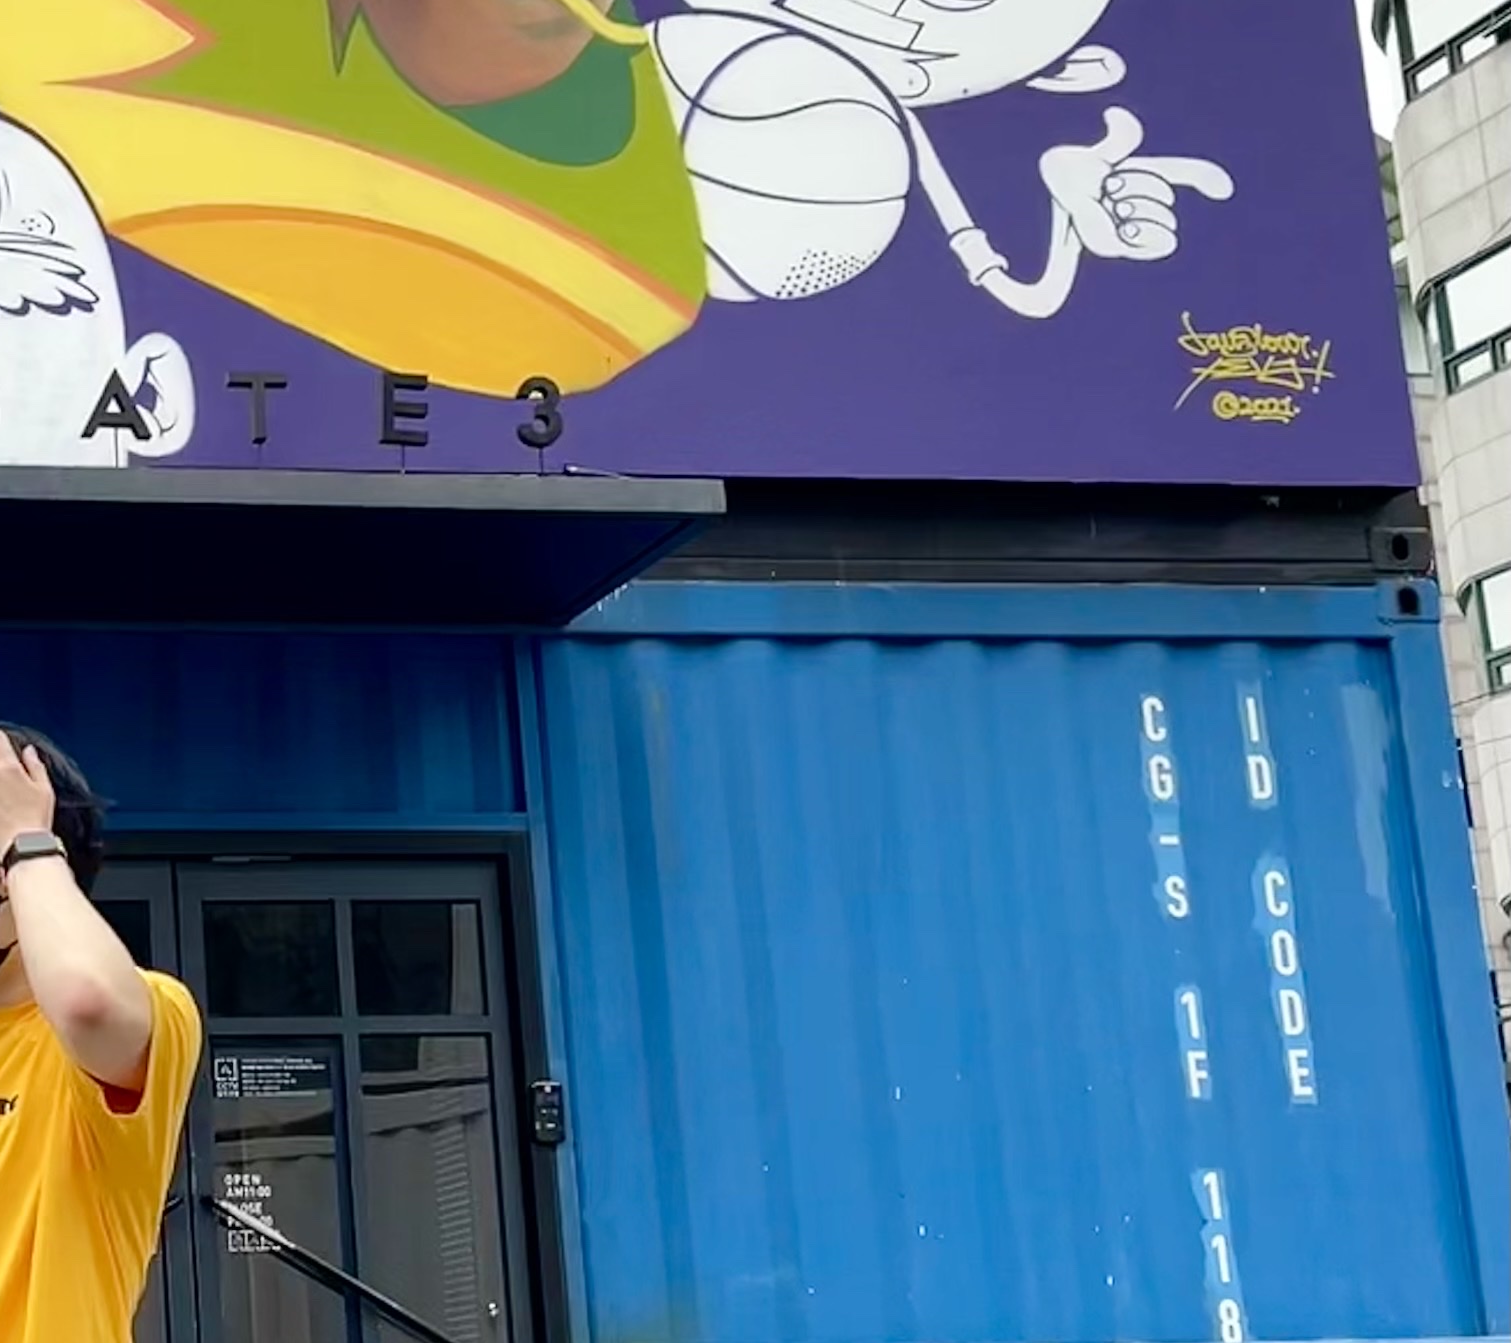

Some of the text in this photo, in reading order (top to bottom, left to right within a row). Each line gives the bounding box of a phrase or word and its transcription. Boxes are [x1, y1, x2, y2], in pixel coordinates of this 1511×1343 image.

[515, 375, 564, 449] 3
[1140, 695, 1189, 919] CG-S
[1178, 990, 1210, 1100] 1F
[1244, 696, 1316, 1098] ID CODE
